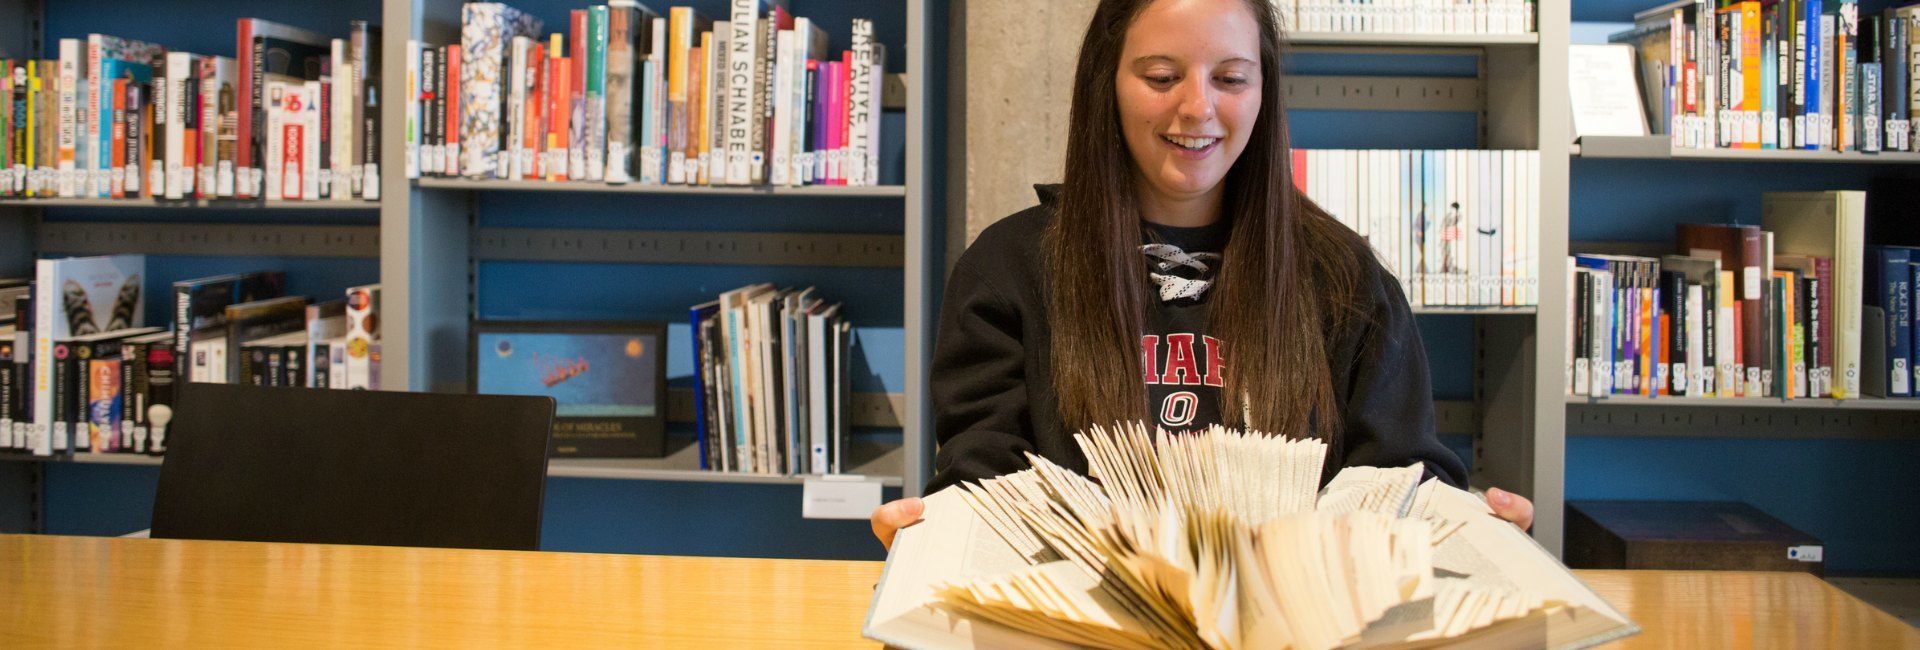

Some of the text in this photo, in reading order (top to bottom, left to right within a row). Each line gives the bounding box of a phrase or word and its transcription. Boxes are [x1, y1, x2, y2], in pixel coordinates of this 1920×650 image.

[857, 19, 872, 123] CREATIVE
[1846, 57, 1855, 112] DIRECTING
[1867, 70, 1876, 103] STAR
[729, 61, 748, 162] SCHNABE
[1810, 280, 1819, 299] How
[1160, 391, 1199, 426] O
